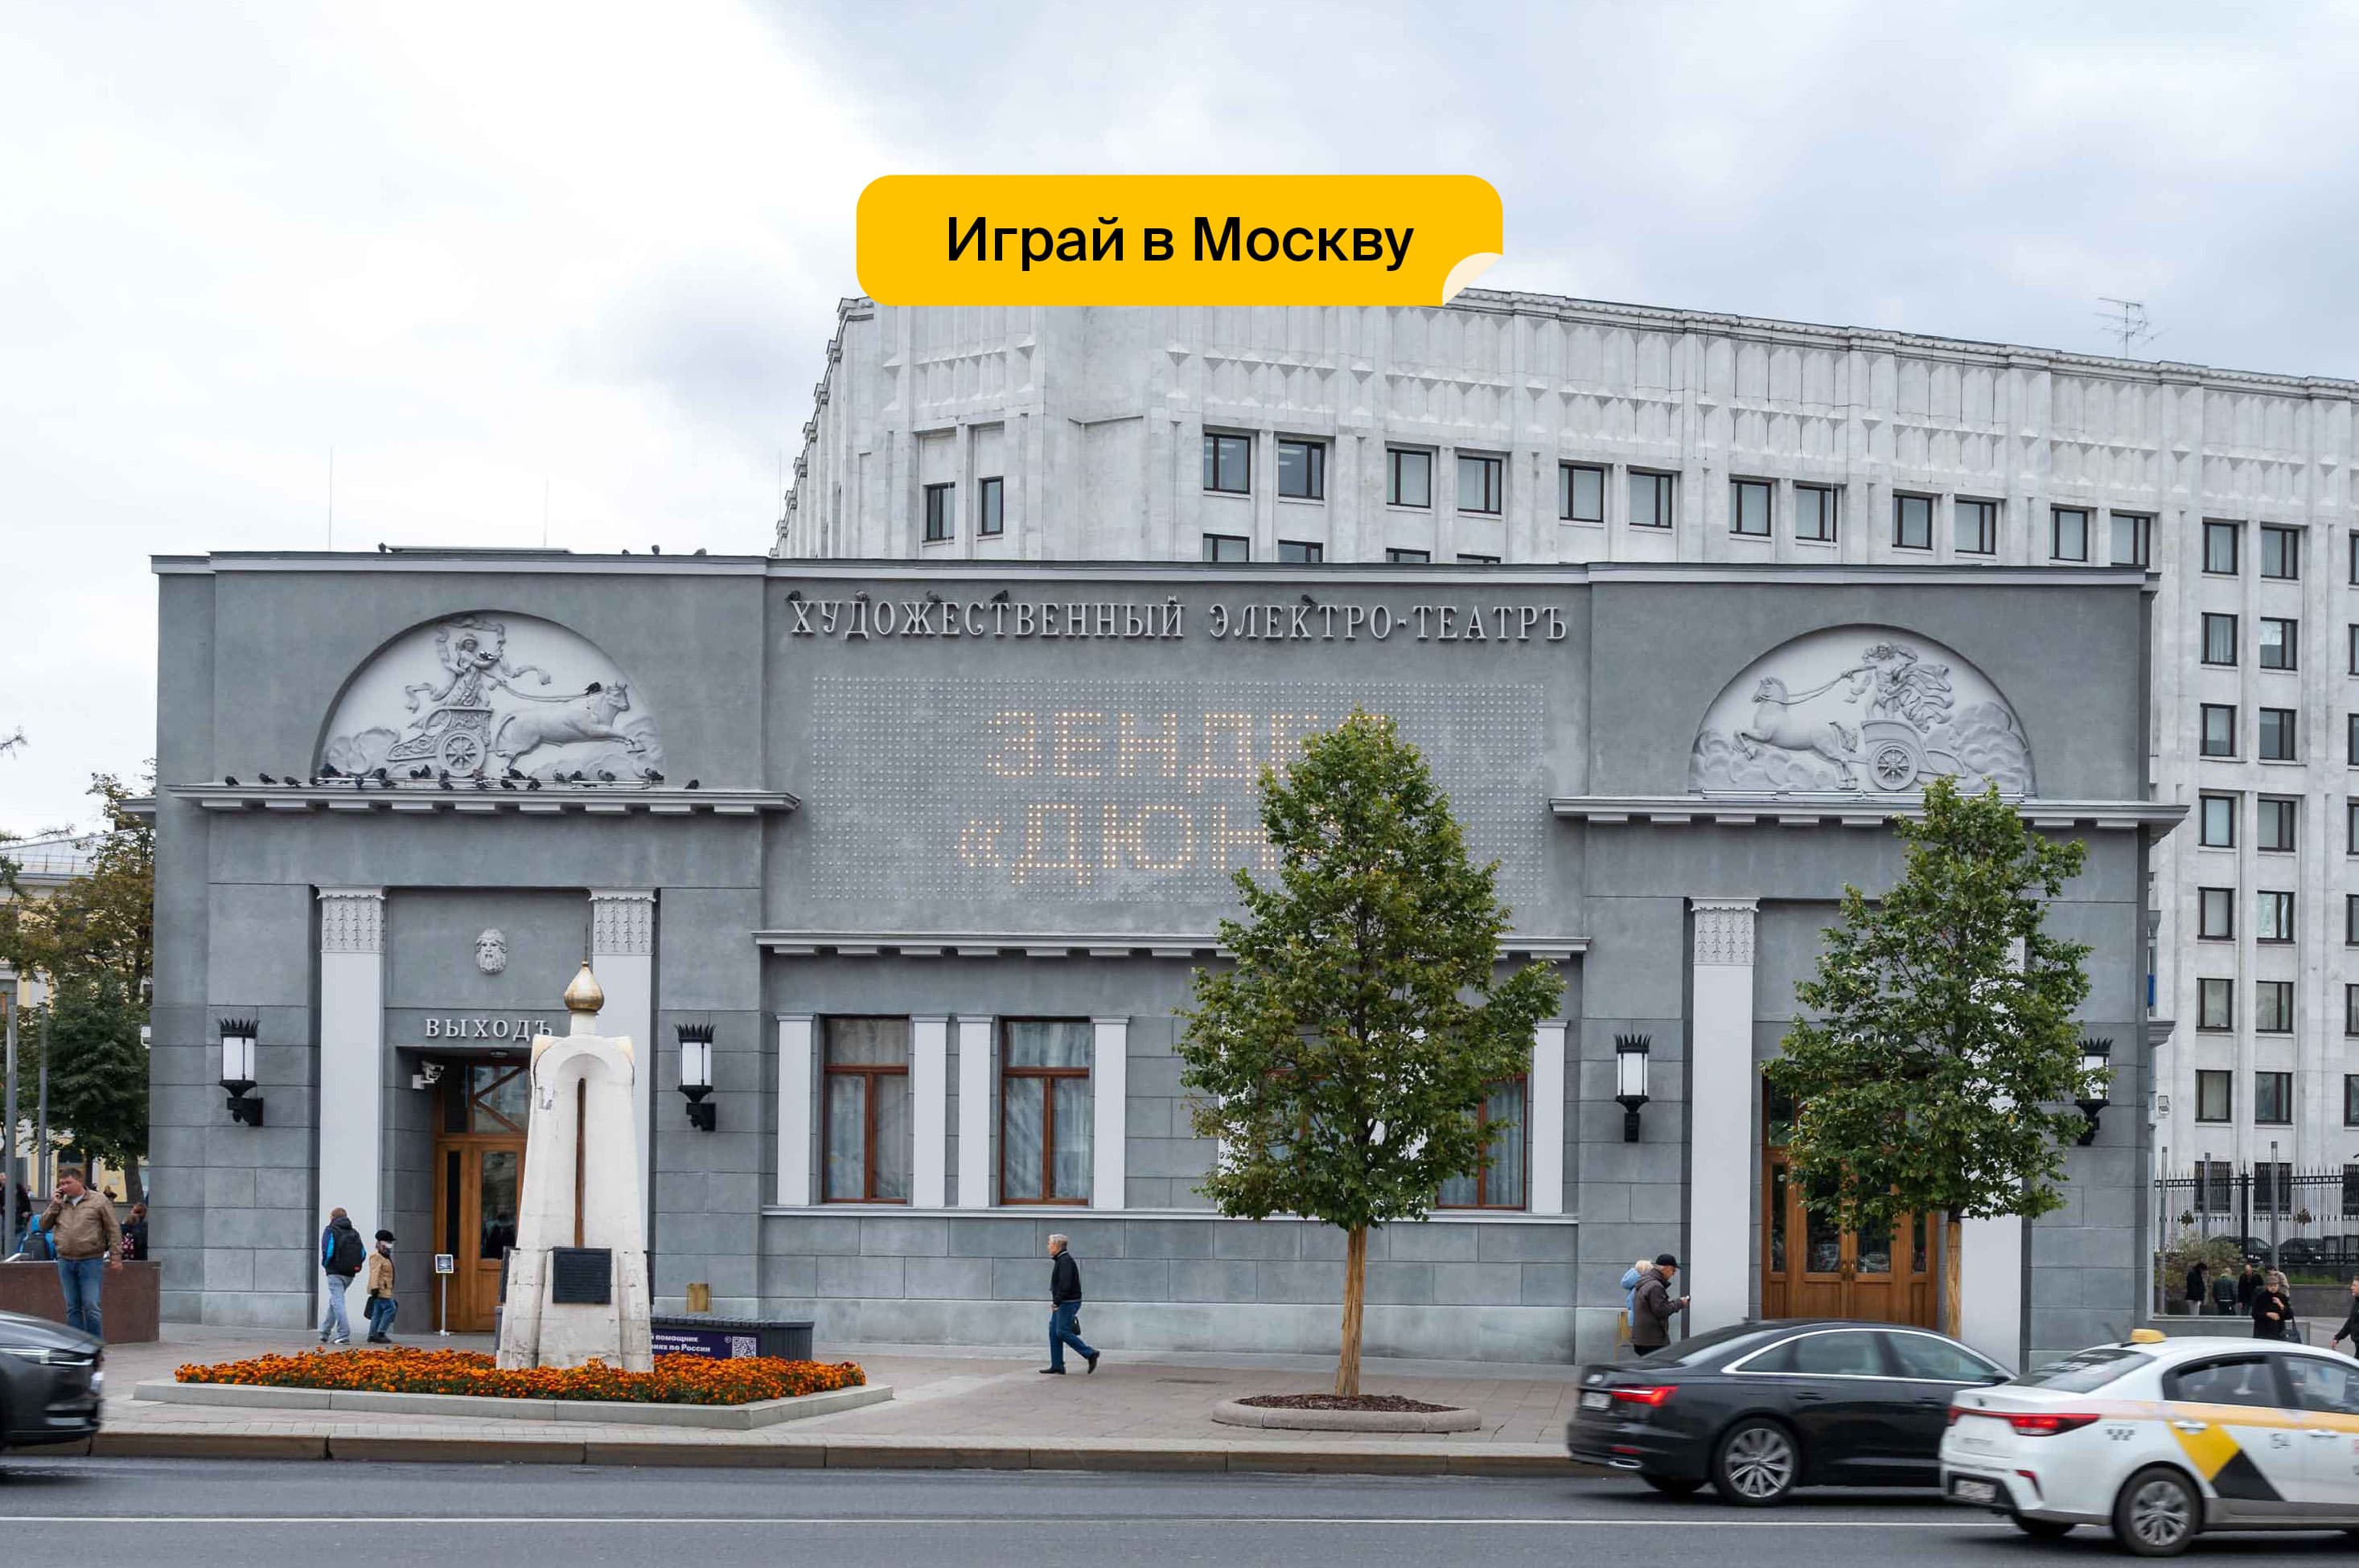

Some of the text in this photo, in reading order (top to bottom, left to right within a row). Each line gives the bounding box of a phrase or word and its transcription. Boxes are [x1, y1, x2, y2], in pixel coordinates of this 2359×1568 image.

[790, 595, 1568, 642] ХУДОЖЕСТВЕННЫЙ ЭЛЕКТРО-ТЕАТРЪ
[988, 710, 1387, 794] ЗЕНДЕ
[425, 1018, 553, 1042] ВЫХОДЪ
[681, 1344, 710, 1352] России
